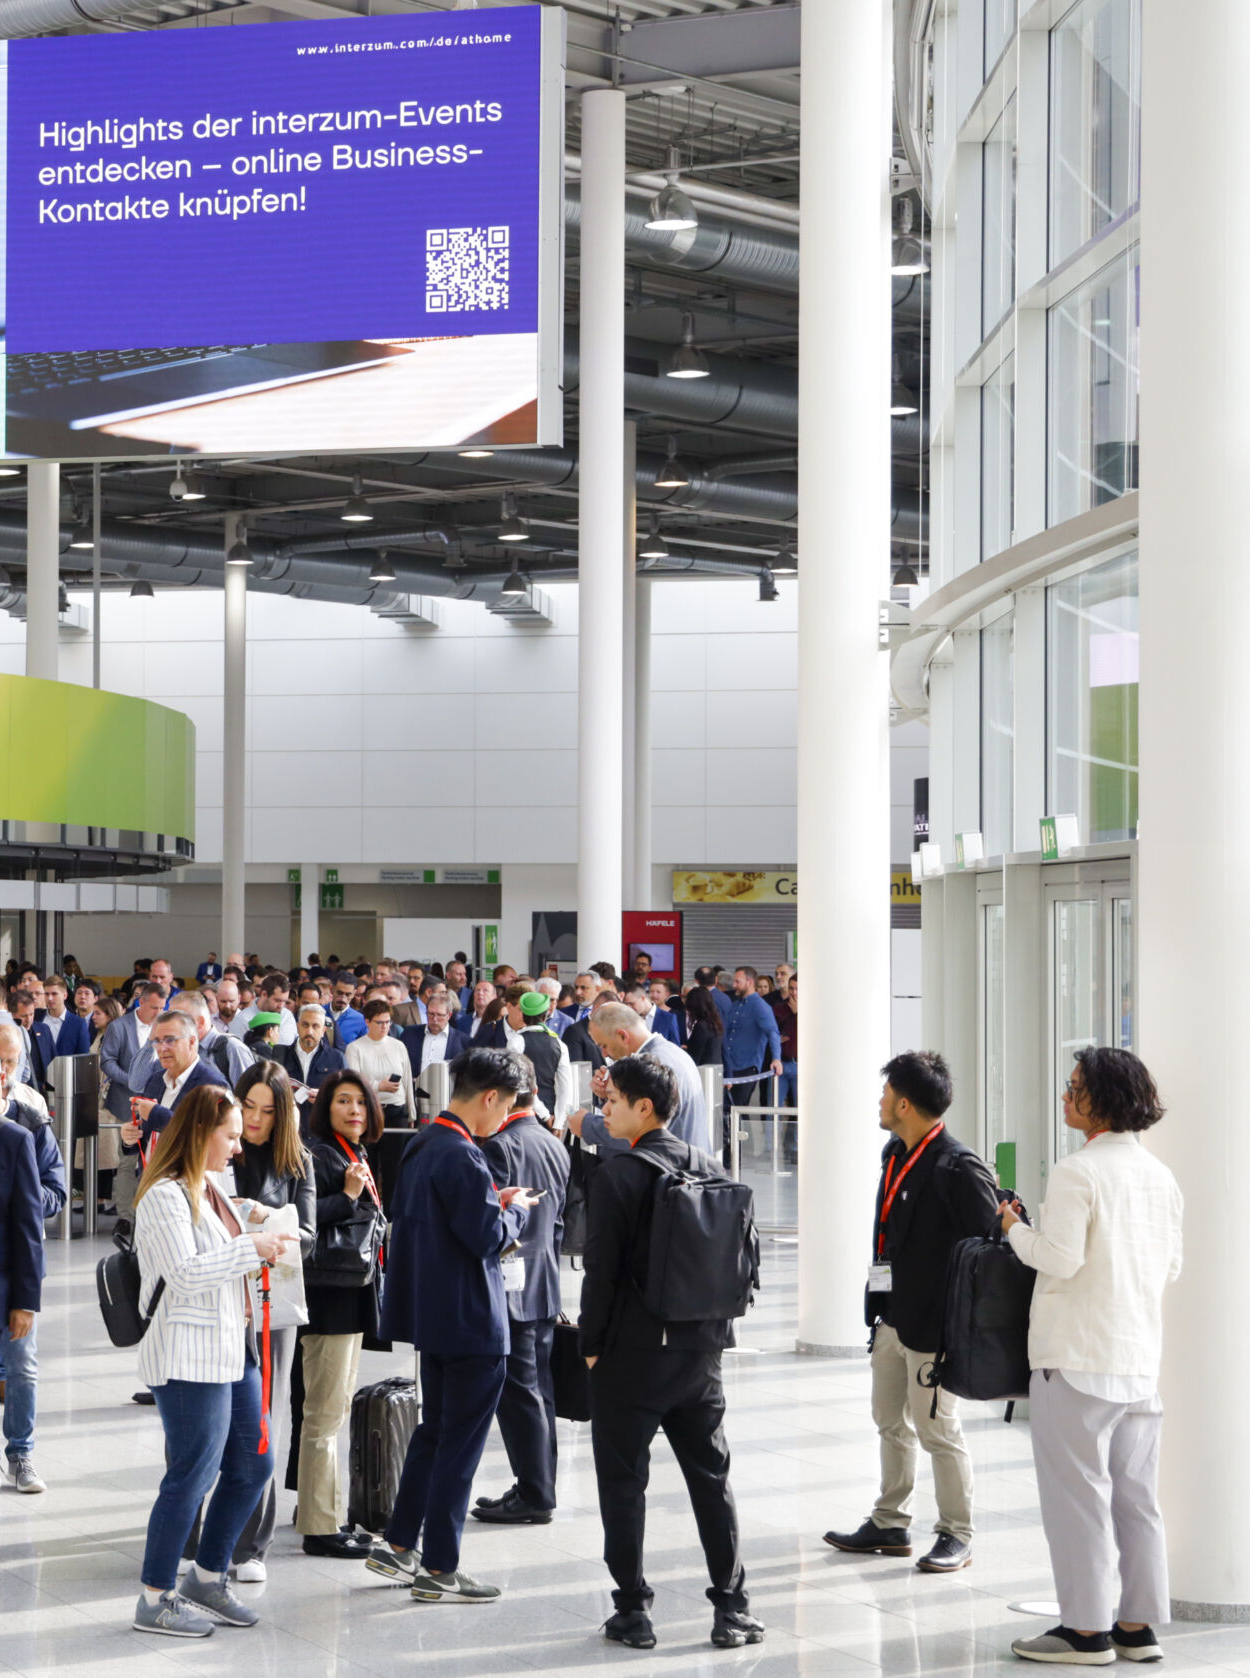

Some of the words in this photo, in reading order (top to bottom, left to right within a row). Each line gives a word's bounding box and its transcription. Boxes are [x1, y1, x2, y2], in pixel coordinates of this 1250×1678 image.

[296, 33, 512, 56] www.interzum.com/de/athome
[39, 117, 184, 152] Highlights
[192, 112, 243, 139] der
[251, 100, 503, 136] interzum-Events
[38, 151, 192, 186] entdecken
[231, 148, 323, 176] online
[332, 142, 484, 170] Business-
[39, 194, 170, 224] Kontakte
[179, 186, 307, 221] knüpfen!
